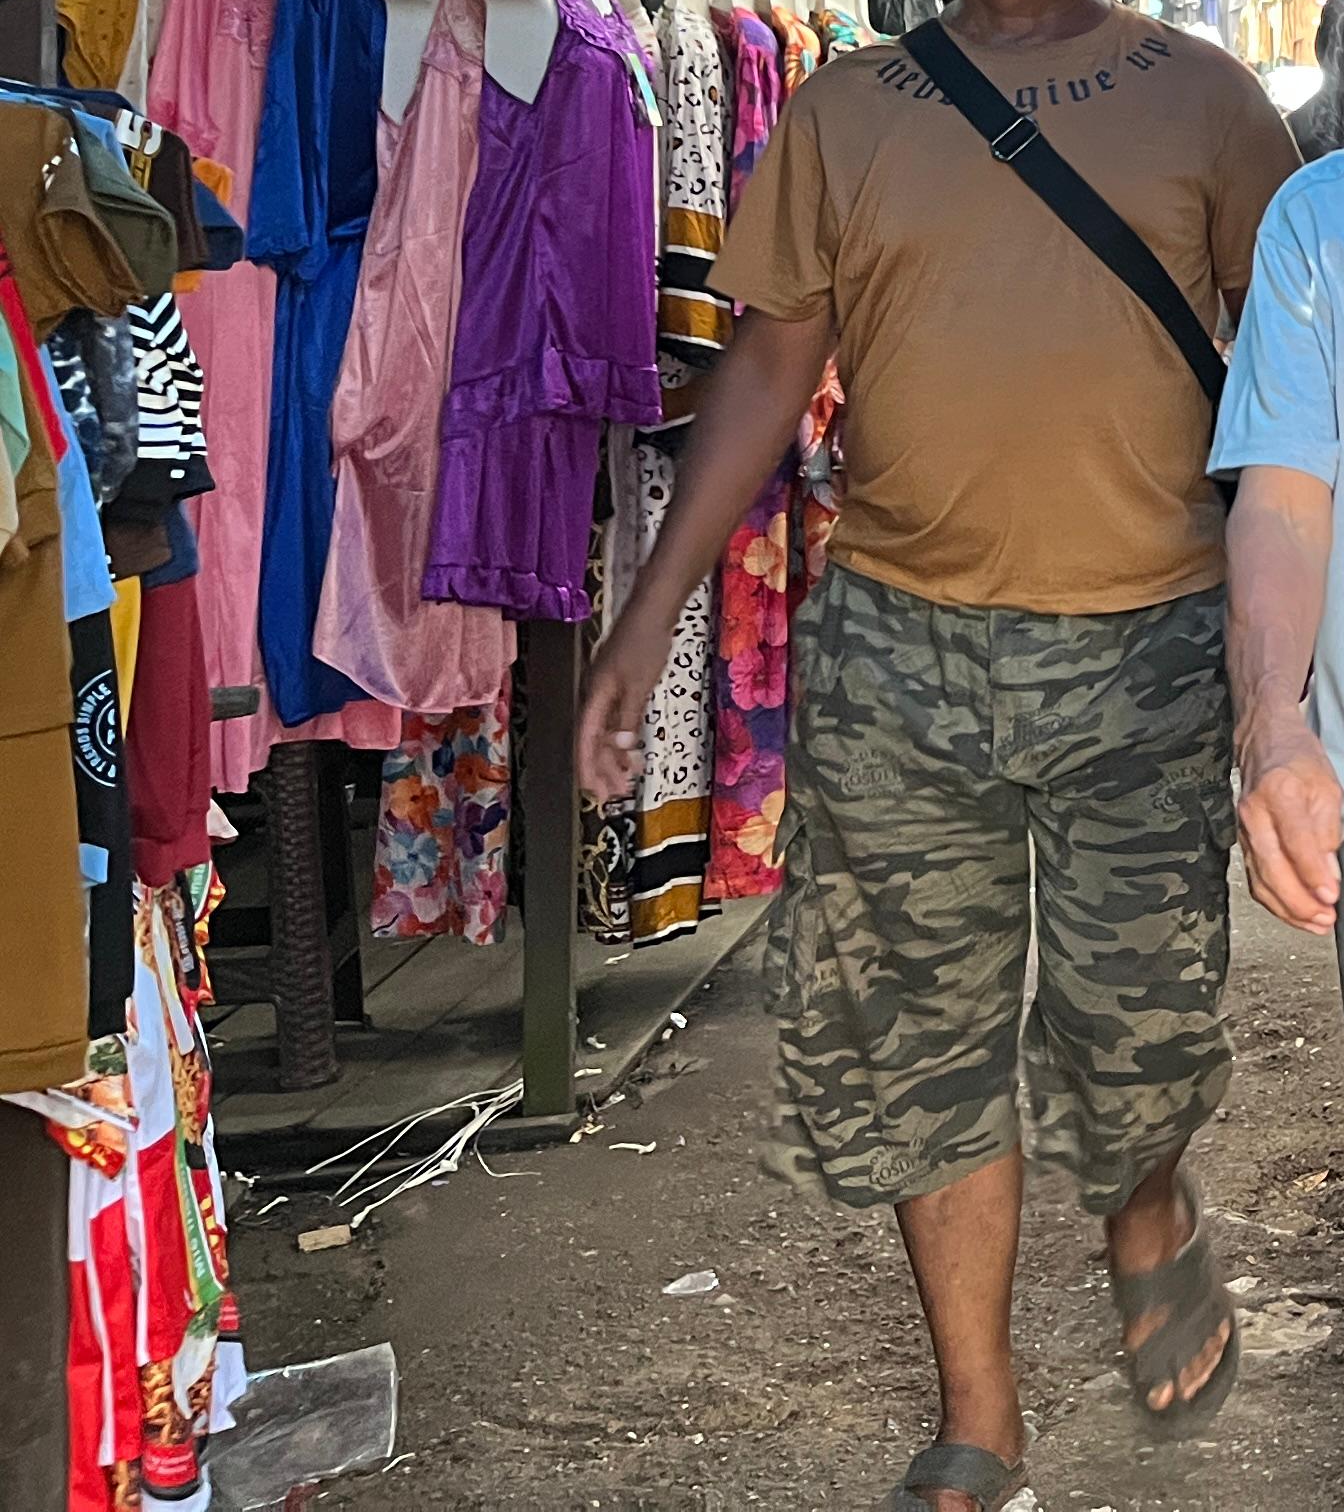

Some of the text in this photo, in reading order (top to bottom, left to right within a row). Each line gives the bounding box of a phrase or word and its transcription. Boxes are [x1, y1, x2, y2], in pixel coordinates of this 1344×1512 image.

[876, 37, 1172, 115] nev give up
